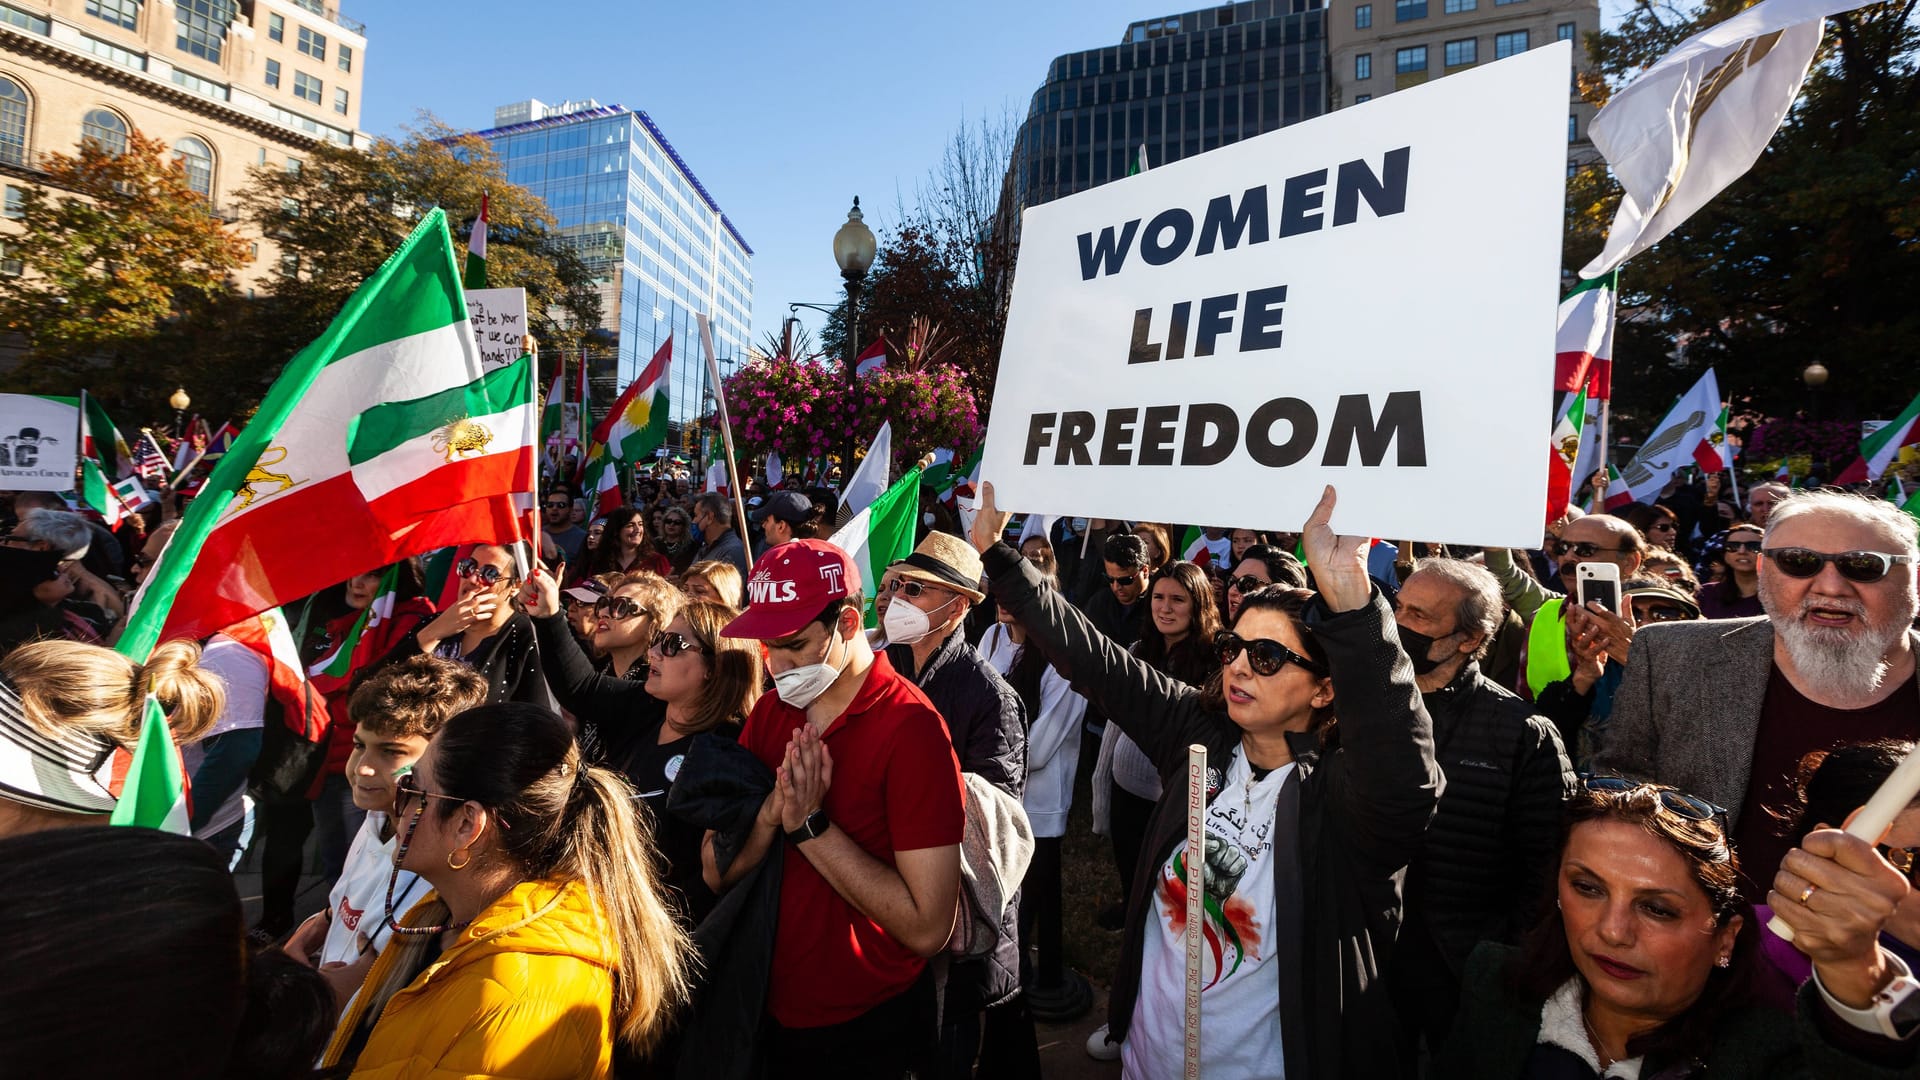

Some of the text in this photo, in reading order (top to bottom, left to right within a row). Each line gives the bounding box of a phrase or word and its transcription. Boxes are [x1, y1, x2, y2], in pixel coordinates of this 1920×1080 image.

[1077, 146, 1411, 281] WOMEN
[487, 310, 497, 325] be
[1128, 285, 1288, 365] LIFE
[1023, 391, 1427, 467] FREEDOM
[819, 563, 844, 594] T
[1190, 764, 1200, 857] CHARLOTTE
[1189, 867, 1199, 908] PIPE
[1188, 968, 1198, 985] PVC
